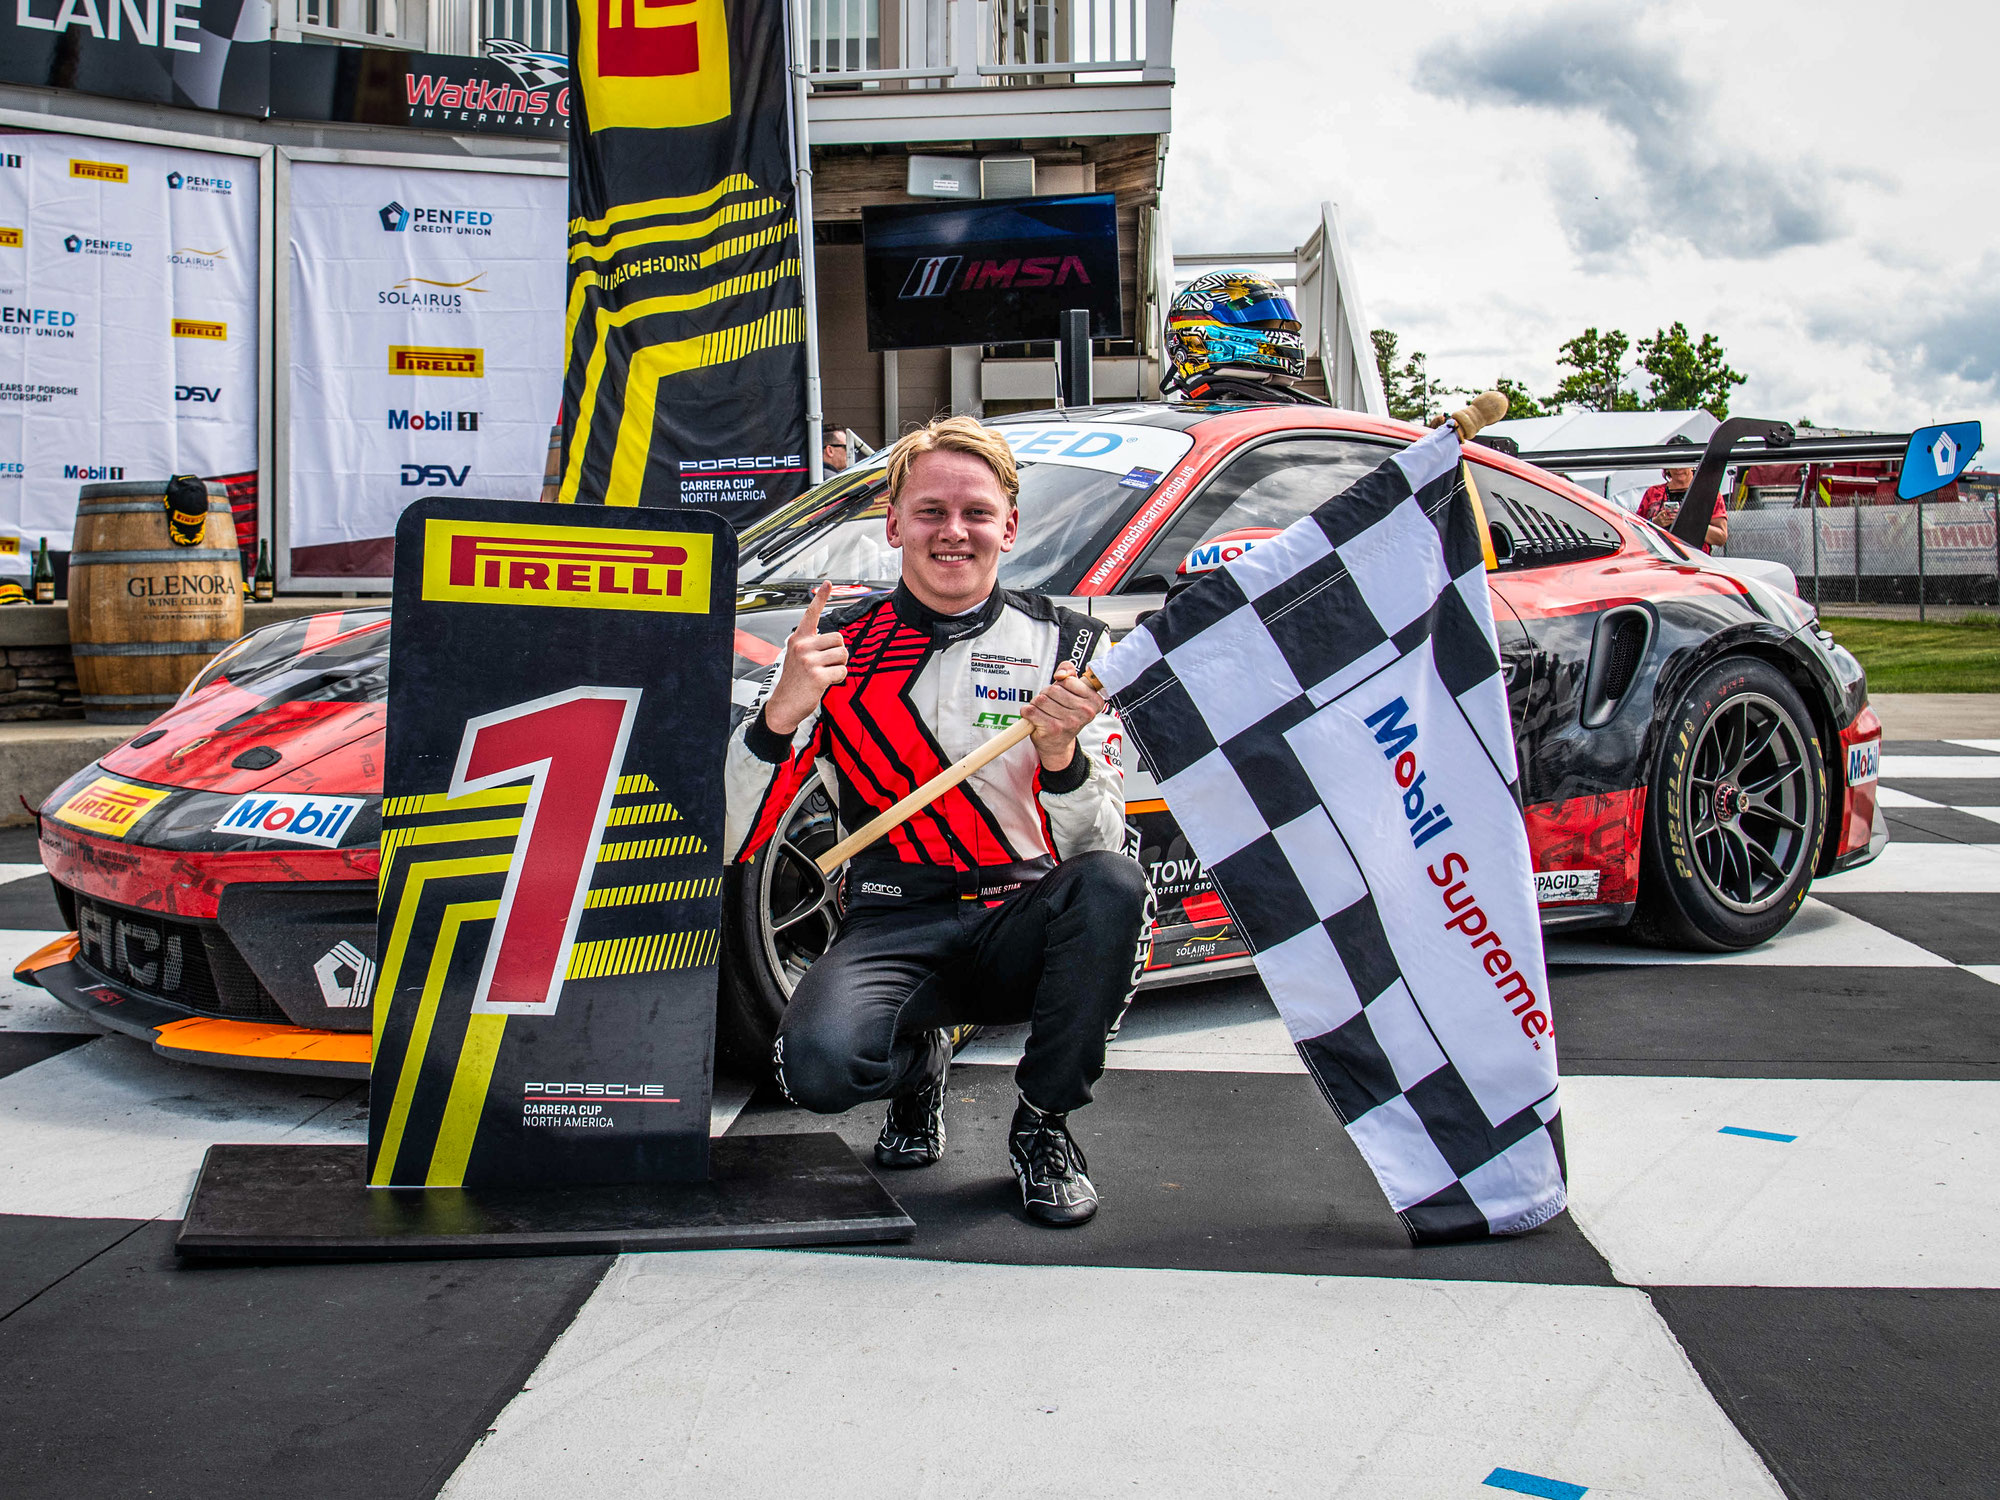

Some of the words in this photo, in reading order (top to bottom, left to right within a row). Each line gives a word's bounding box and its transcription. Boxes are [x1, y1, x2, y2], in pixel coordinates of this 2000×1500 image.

[17, 0, 201, 53] LANE
[405, 73, 549, 115] Watkins
[74, 162, 124, 180] PIRELLI
[187, 176, 232, 189] PENFED
[414, 208, 493, 226] PENFED
[413, 224, 453, 234] CREDIT
[456, 226, 492, 236] UNION
[85, 239, 132, 252] PENFED
[167, 255, 214, 267] SOLAIRUS
[611, 254, 699, 289] RACEBORN
[960, 256, 1091, 290] IMSA
[378, 291, 462, 307] SOLAIRUS
[0, 306, 75, 327] ENFED
[411, 306, 462, 314] AVIATION
[36, 327, 75, 338] UNION
[175, 322, 223, 337] PIRELLI
[396, 351, 476, 372] PIRELLI
[25, 384, 36, 392] OF
[38, 385, 78, 396] PORSCHE
[175, 385, 221, 402] DSV
[388, 409, 452, 431] Mobil
[679, 455, 801, 471] PORSCHE
[64, 464, 107, 480] Mobil
[401, 464, 471, 487] DSV
[680, 479, 731, 491] CARRERA
[733, 478, 755, 489] CUP
[680, 492, 718, 503] NORTH
[720, 490, 766, 502] AMERICA
[1088, 465, 1196, 586] www.porschecarreracup.us
[449, 534, 689, 597] PIRELLI
[127, 575, 236, 598] GLENORA
[148, 597, 178, 607] WINE
[181, 597, 223, 606] CELLARS
[971, 652, 1032, 664] PORSCHE
[1071, 628, 1091, 676] parco
[975, 684, 1017, 702] Mobil
[972, 722, 1008, 731] MOTORS
[977, 711, 1022, 727] AC
[1850, 747, 1879, 781] Mobil
[1364, 696, 1453, 849] Mobil
[67, 786, 151, 825] PIRELLI
[1668, 731, 1693, 878] PIRELLI
[223, 799, 355, 840] Mobil
[446, 686, 643, 1015] 1
[862, 882, 902, 895] sparco
[980, 886, 1002, 896] JANNE
[1153, 883, 1190, 895] ROPERTY
[1538, 874, 1580, 892] PAGID
[1175, 943, 1216, 957] SOLAIRUS
[524, 1082, 664, 1095] PORSCHE
[523, 1104, 576, 1115] CARRERA
[579, 1105, 602, 1116] CUP
[522, 1116, 561, 1127] NORTH
[564, 1117, 614, 1128] AMERICA
